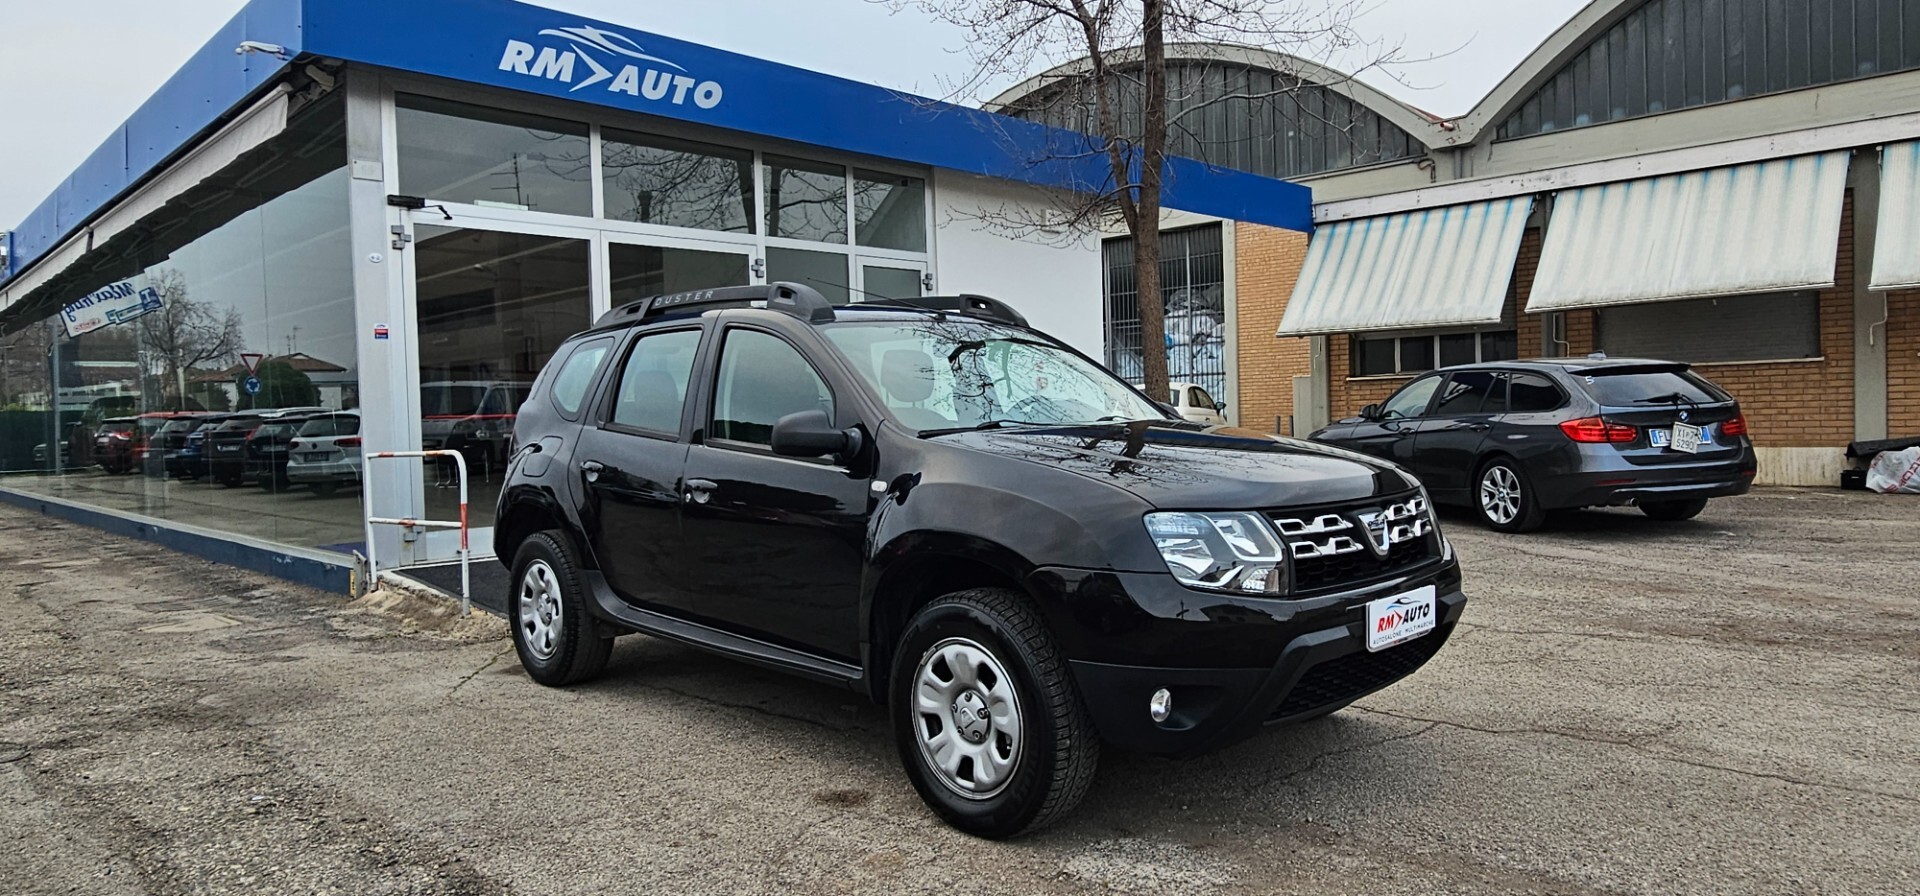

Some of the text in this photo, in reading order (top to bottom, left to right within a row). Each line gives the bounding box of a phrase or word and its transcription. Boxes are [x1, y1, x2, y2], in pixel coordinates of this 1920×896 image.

[498, 39, 723, 109] RM AUTO
[655, 290, 714, 306] DUSTER
[1377, 603, 1430, 633] RM AUTO
[1373, 630, 1402, 645] AUTOSALONE
